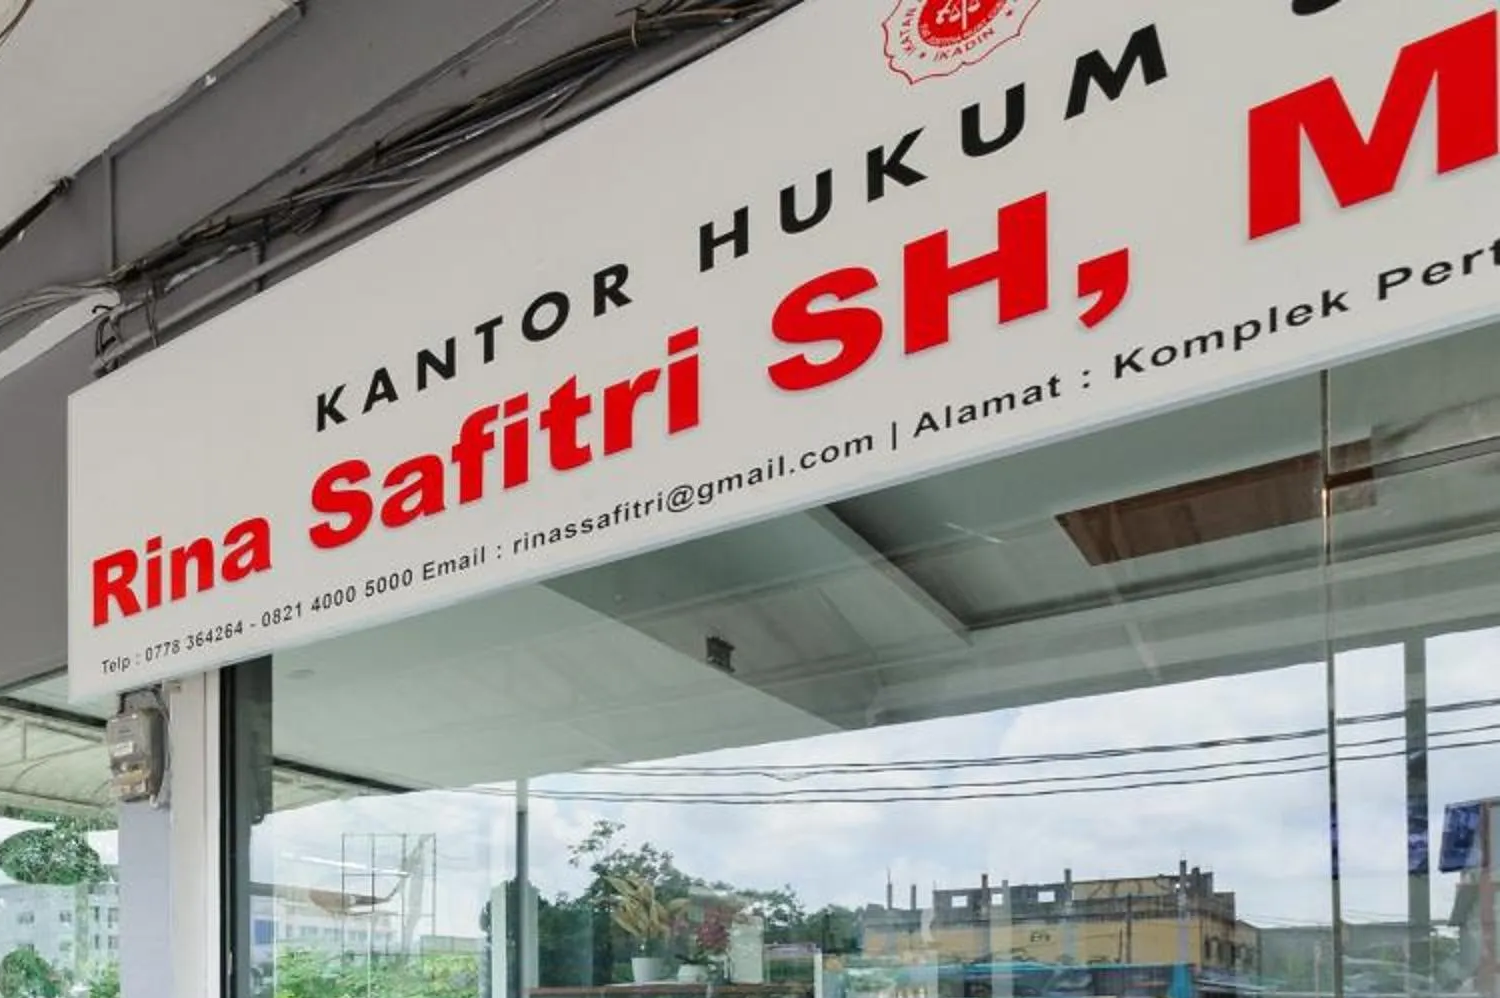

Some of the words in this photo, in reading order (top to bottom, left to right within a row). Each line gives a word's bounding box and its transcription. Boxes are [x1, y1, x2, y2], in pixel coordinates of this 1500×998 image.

[316, 263, 633, 433] KANTOR
[699, 23, 1168, 273] HUKUM
[932, 27, 996, 62] IKADIN
[91, 518, 272, 627] Rina
[308, 327, 700, 549] Safitri
[768, 192, 1130, 392] SH,
[101, 657, 131, 674] Telp
[144, 638, 181, 663] 0778
[186, 619, 244, 650] 364264
[261, 602, 302, 627] 0821
[310, 585, 357, 612] 4000
[365, 568, 414, 598] 5000
[422, 545, 486, 581] Email
[512, 434, 874, 555] rinassafitri@gmail.com
[913, 374, 1062, 440] Alamat
[1114, 289, 1350, 380] Komplek
